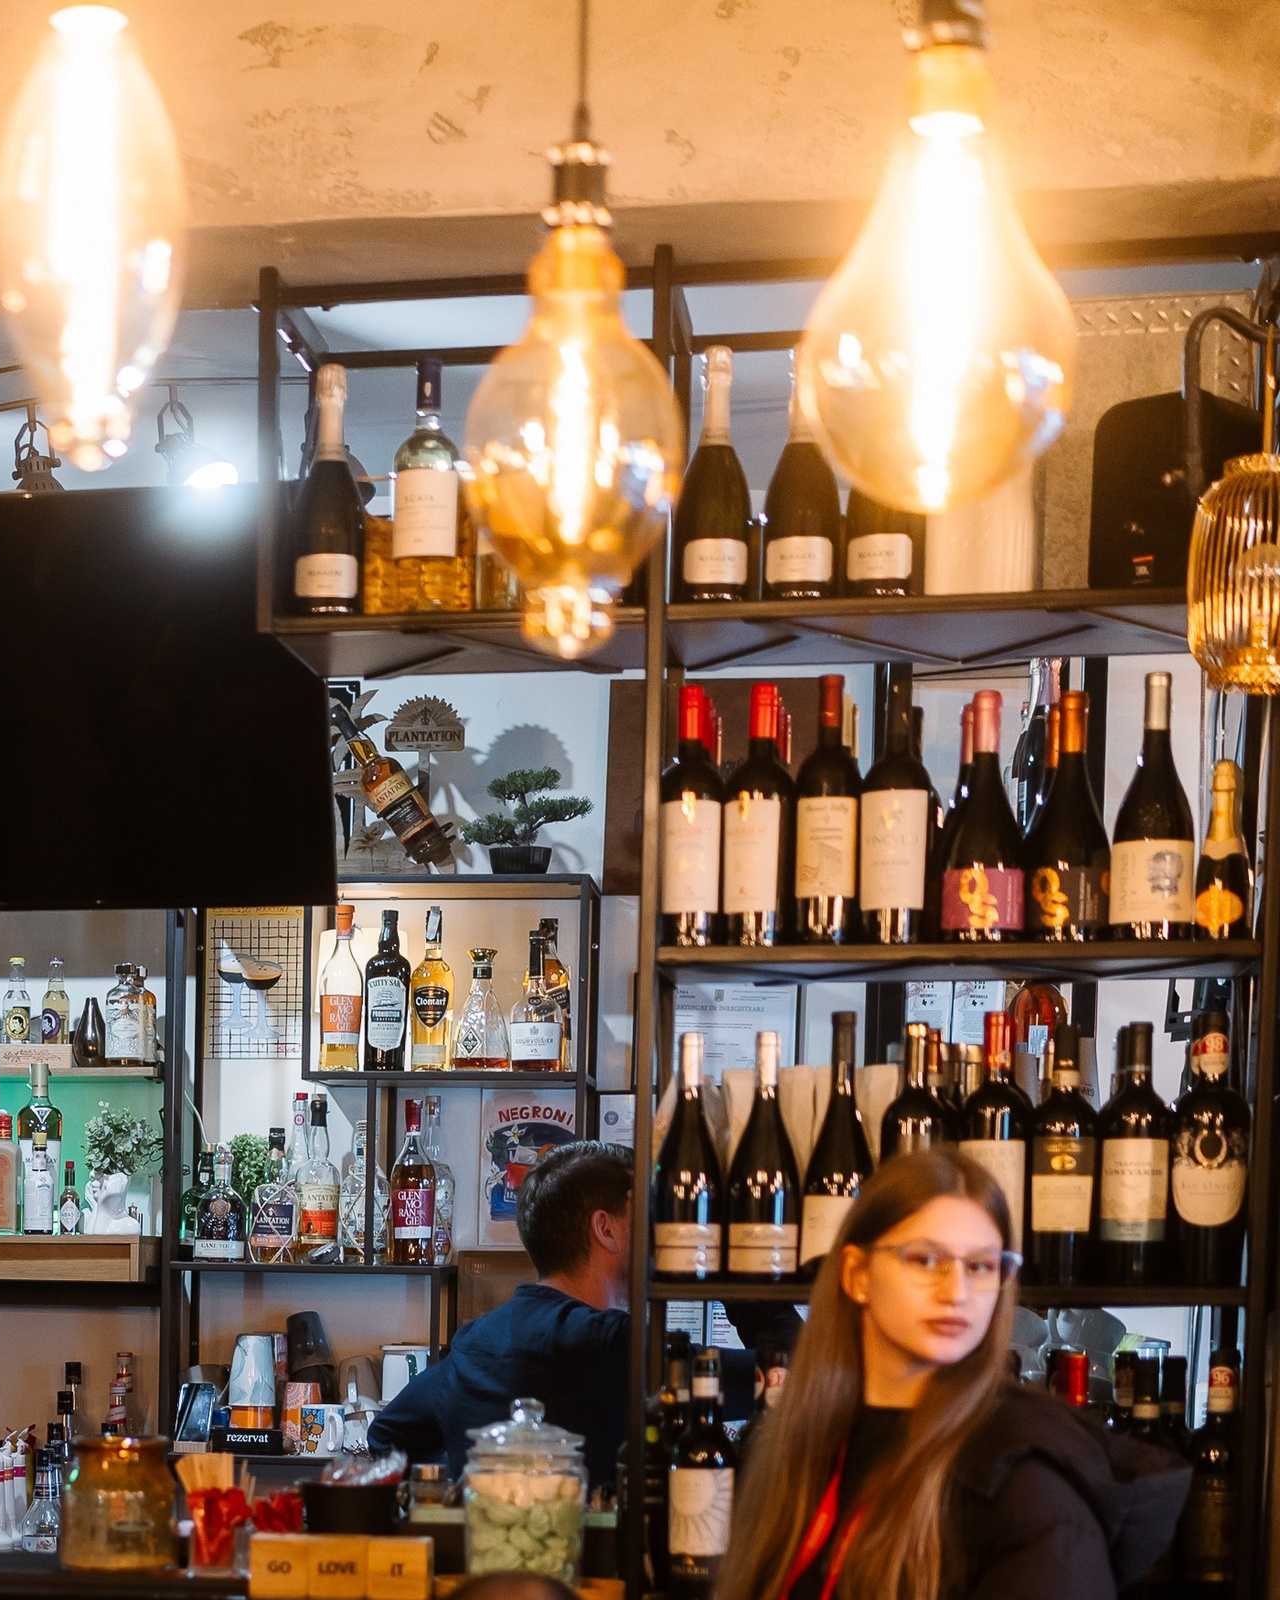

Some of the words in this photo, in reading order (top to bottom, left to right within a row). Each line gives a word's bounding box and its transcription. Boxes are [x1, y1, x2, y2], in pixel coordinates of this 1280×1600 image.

[388, 730, 462, 742] PLANTATION
[375, 780, 407, 805] ANTATION
[329, 996, 354, 1005] GLEN
[415, 996, 447, 1005] Clontarf
[337, 1005, 354, 1014] MO
[329, 1014, 348, 1023] RAN
[336, 1022, 351, 1031] GIE
[498, 1106, 574, 1126] NEGRONI
[302, 1193, 338, 1202] ANTATION
[397, 1191, 422, 1200] GLEN
[405, 1200, 422, 1208] MO
[398, 1208, 417, 1217] RAN
[405, 1216, 421, 1226] GIE
[226, 1433, 269, 1443] rezervat
[267, 1561, 292, 1574] GO
[318, 1561, 358, 1575] LOVE
[390, 1563, 404, 1577] IT
